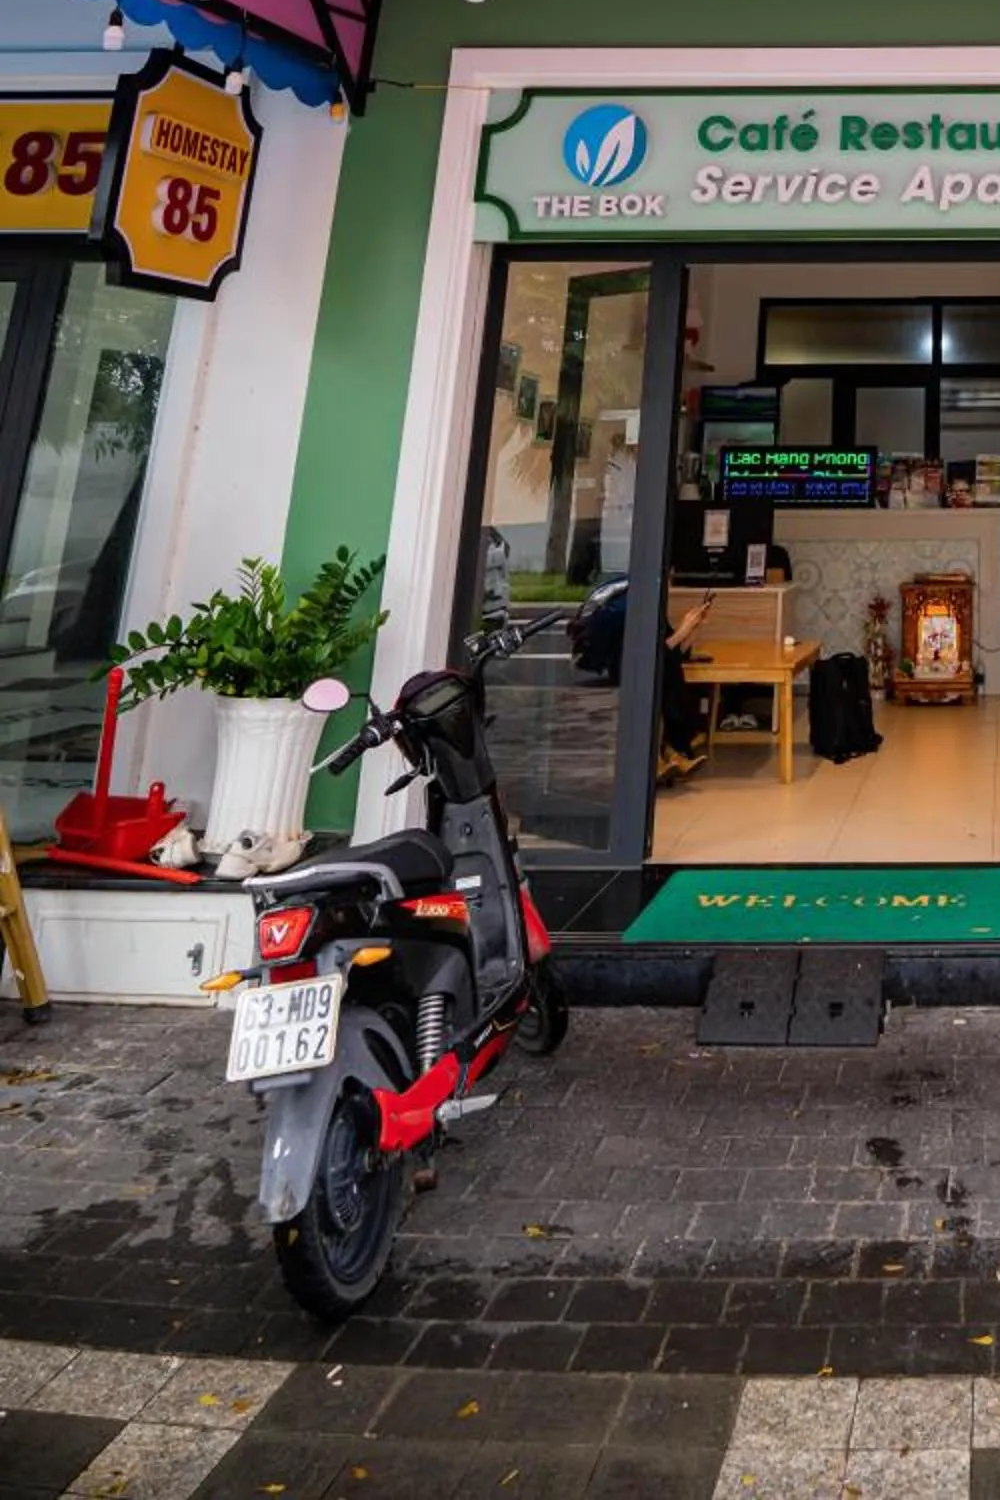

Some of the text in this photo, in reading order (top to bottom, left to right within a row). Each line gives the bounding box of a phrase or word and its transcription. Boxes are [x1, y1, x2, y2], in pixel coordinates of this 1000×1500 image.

[155, 118, 249, 176] HOMESTAY
[697, 109, 820, 153] Café
[4, 131, 106, 196] 85
[690, 164, 880, 204] Service
[162, 177, 221, 242] 85
[534, 194, 664, 218] THE BOK
[697, 894, 967, 908] WELCOME
[236, 1024, 329, 1073] 001.62
